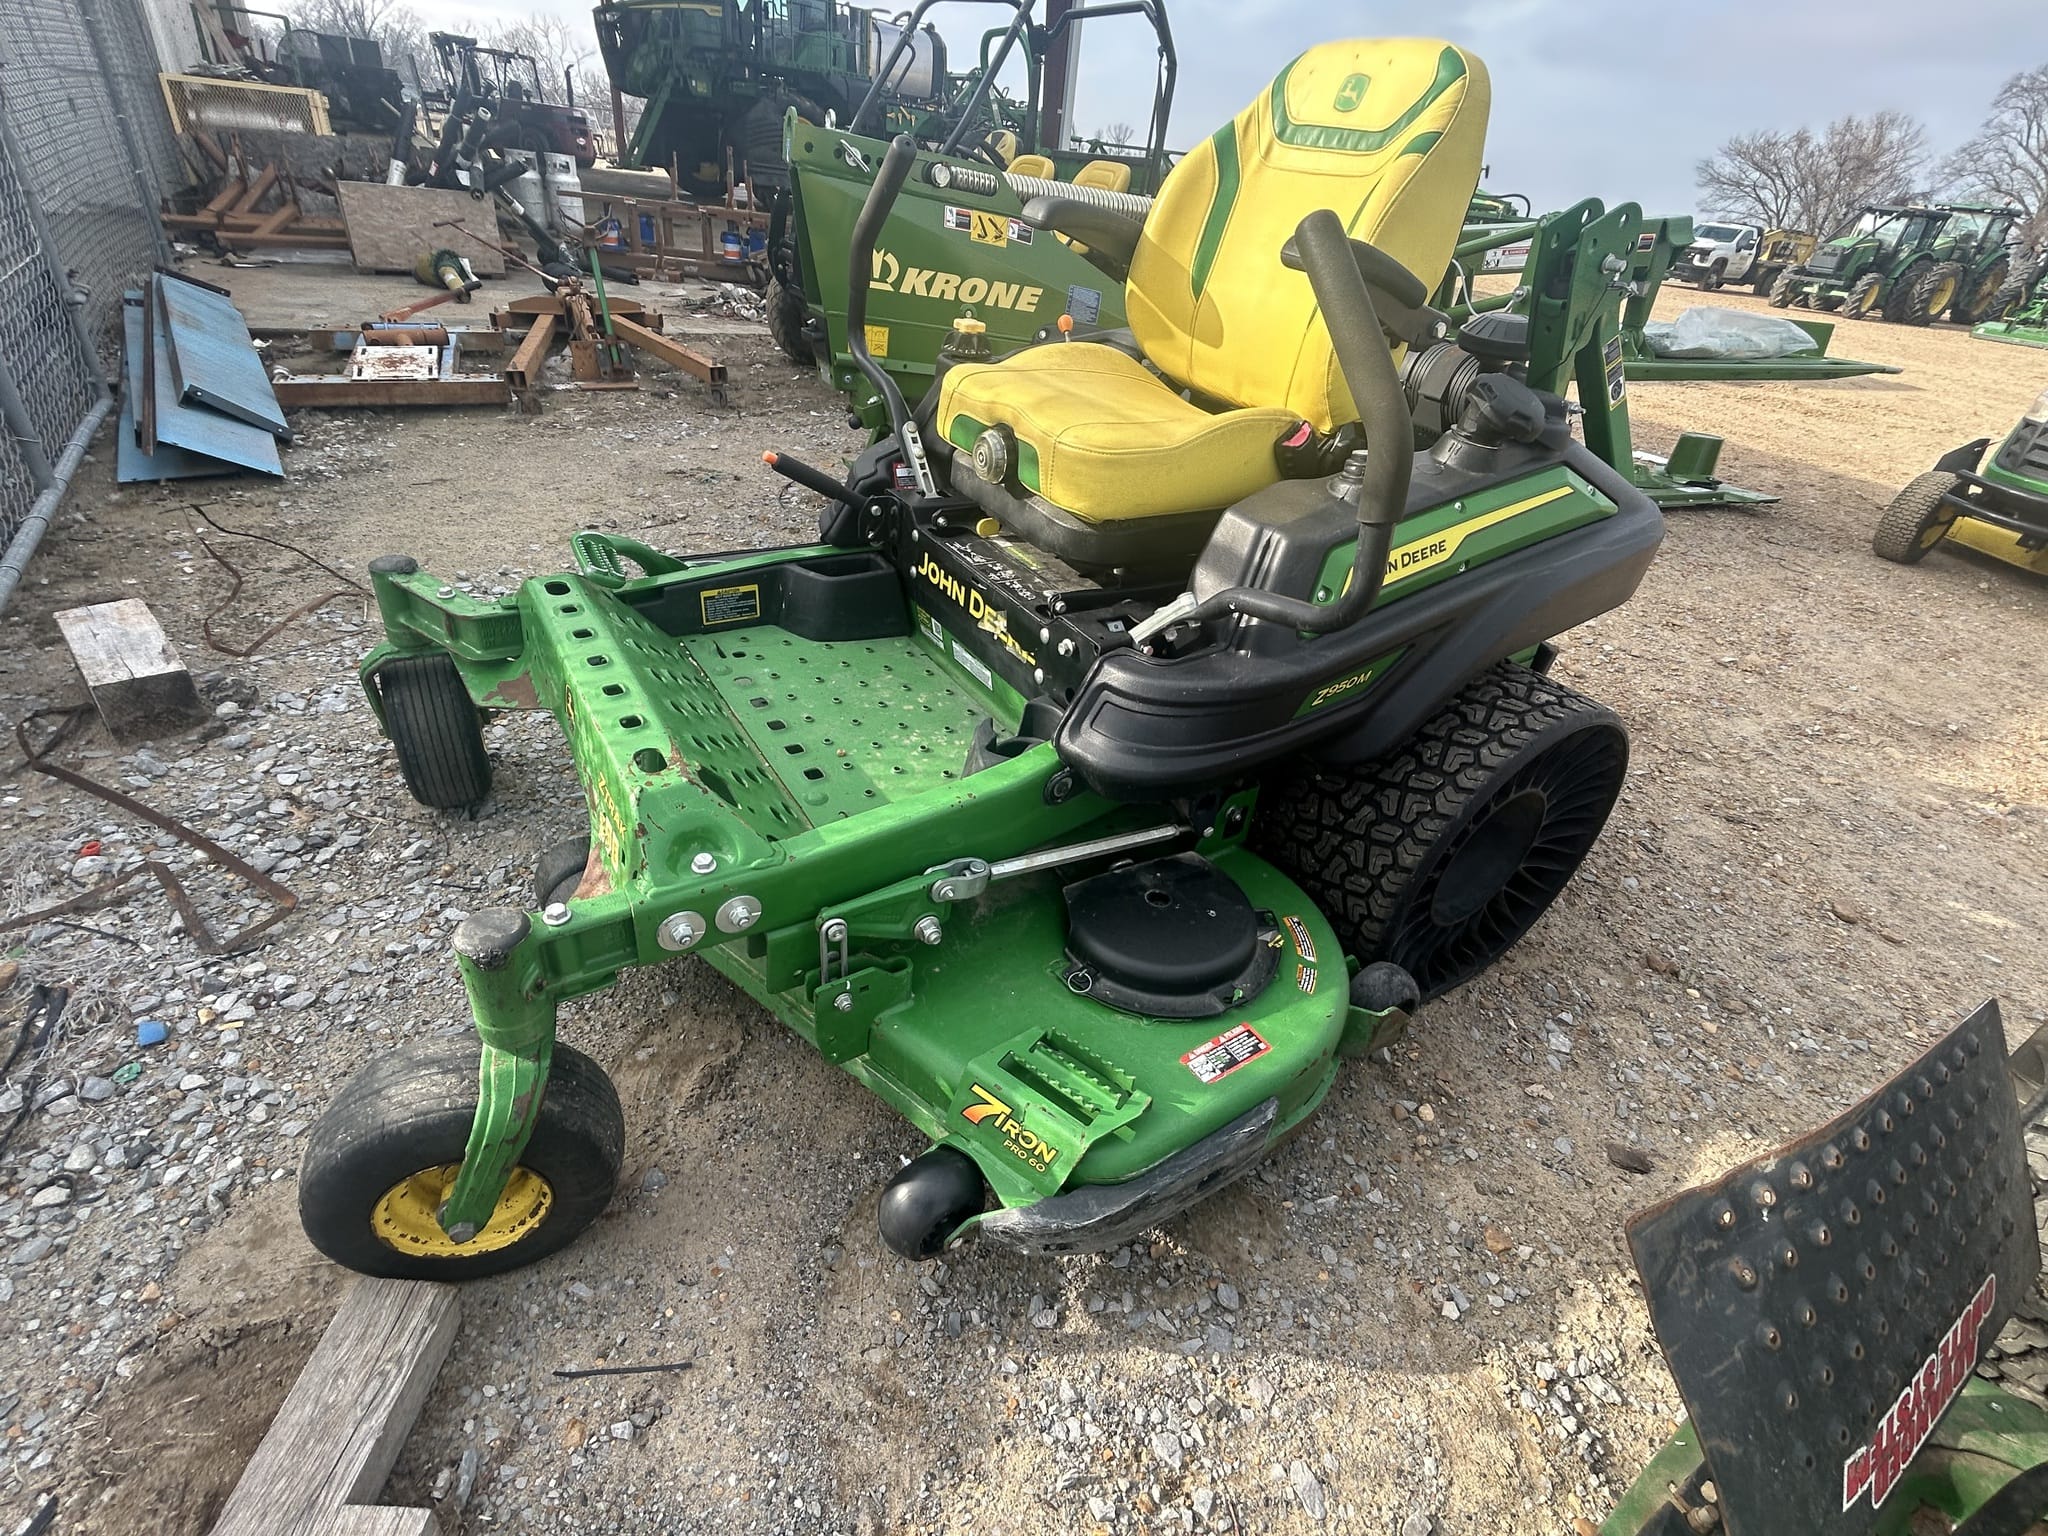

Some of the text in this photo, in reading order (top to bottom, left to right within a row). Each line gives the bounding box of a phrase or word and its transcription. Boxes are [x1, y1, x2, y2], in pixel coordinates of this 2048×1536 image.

[899, 267, 1043, 313] KRONE
[1401, 540, 1446, 569] DEERE
[918, 552, 965, 607] JOHN
[1312, 670, 1373, 706] Z950M
[1003, 1139, 1047, 1173] PRO 60
